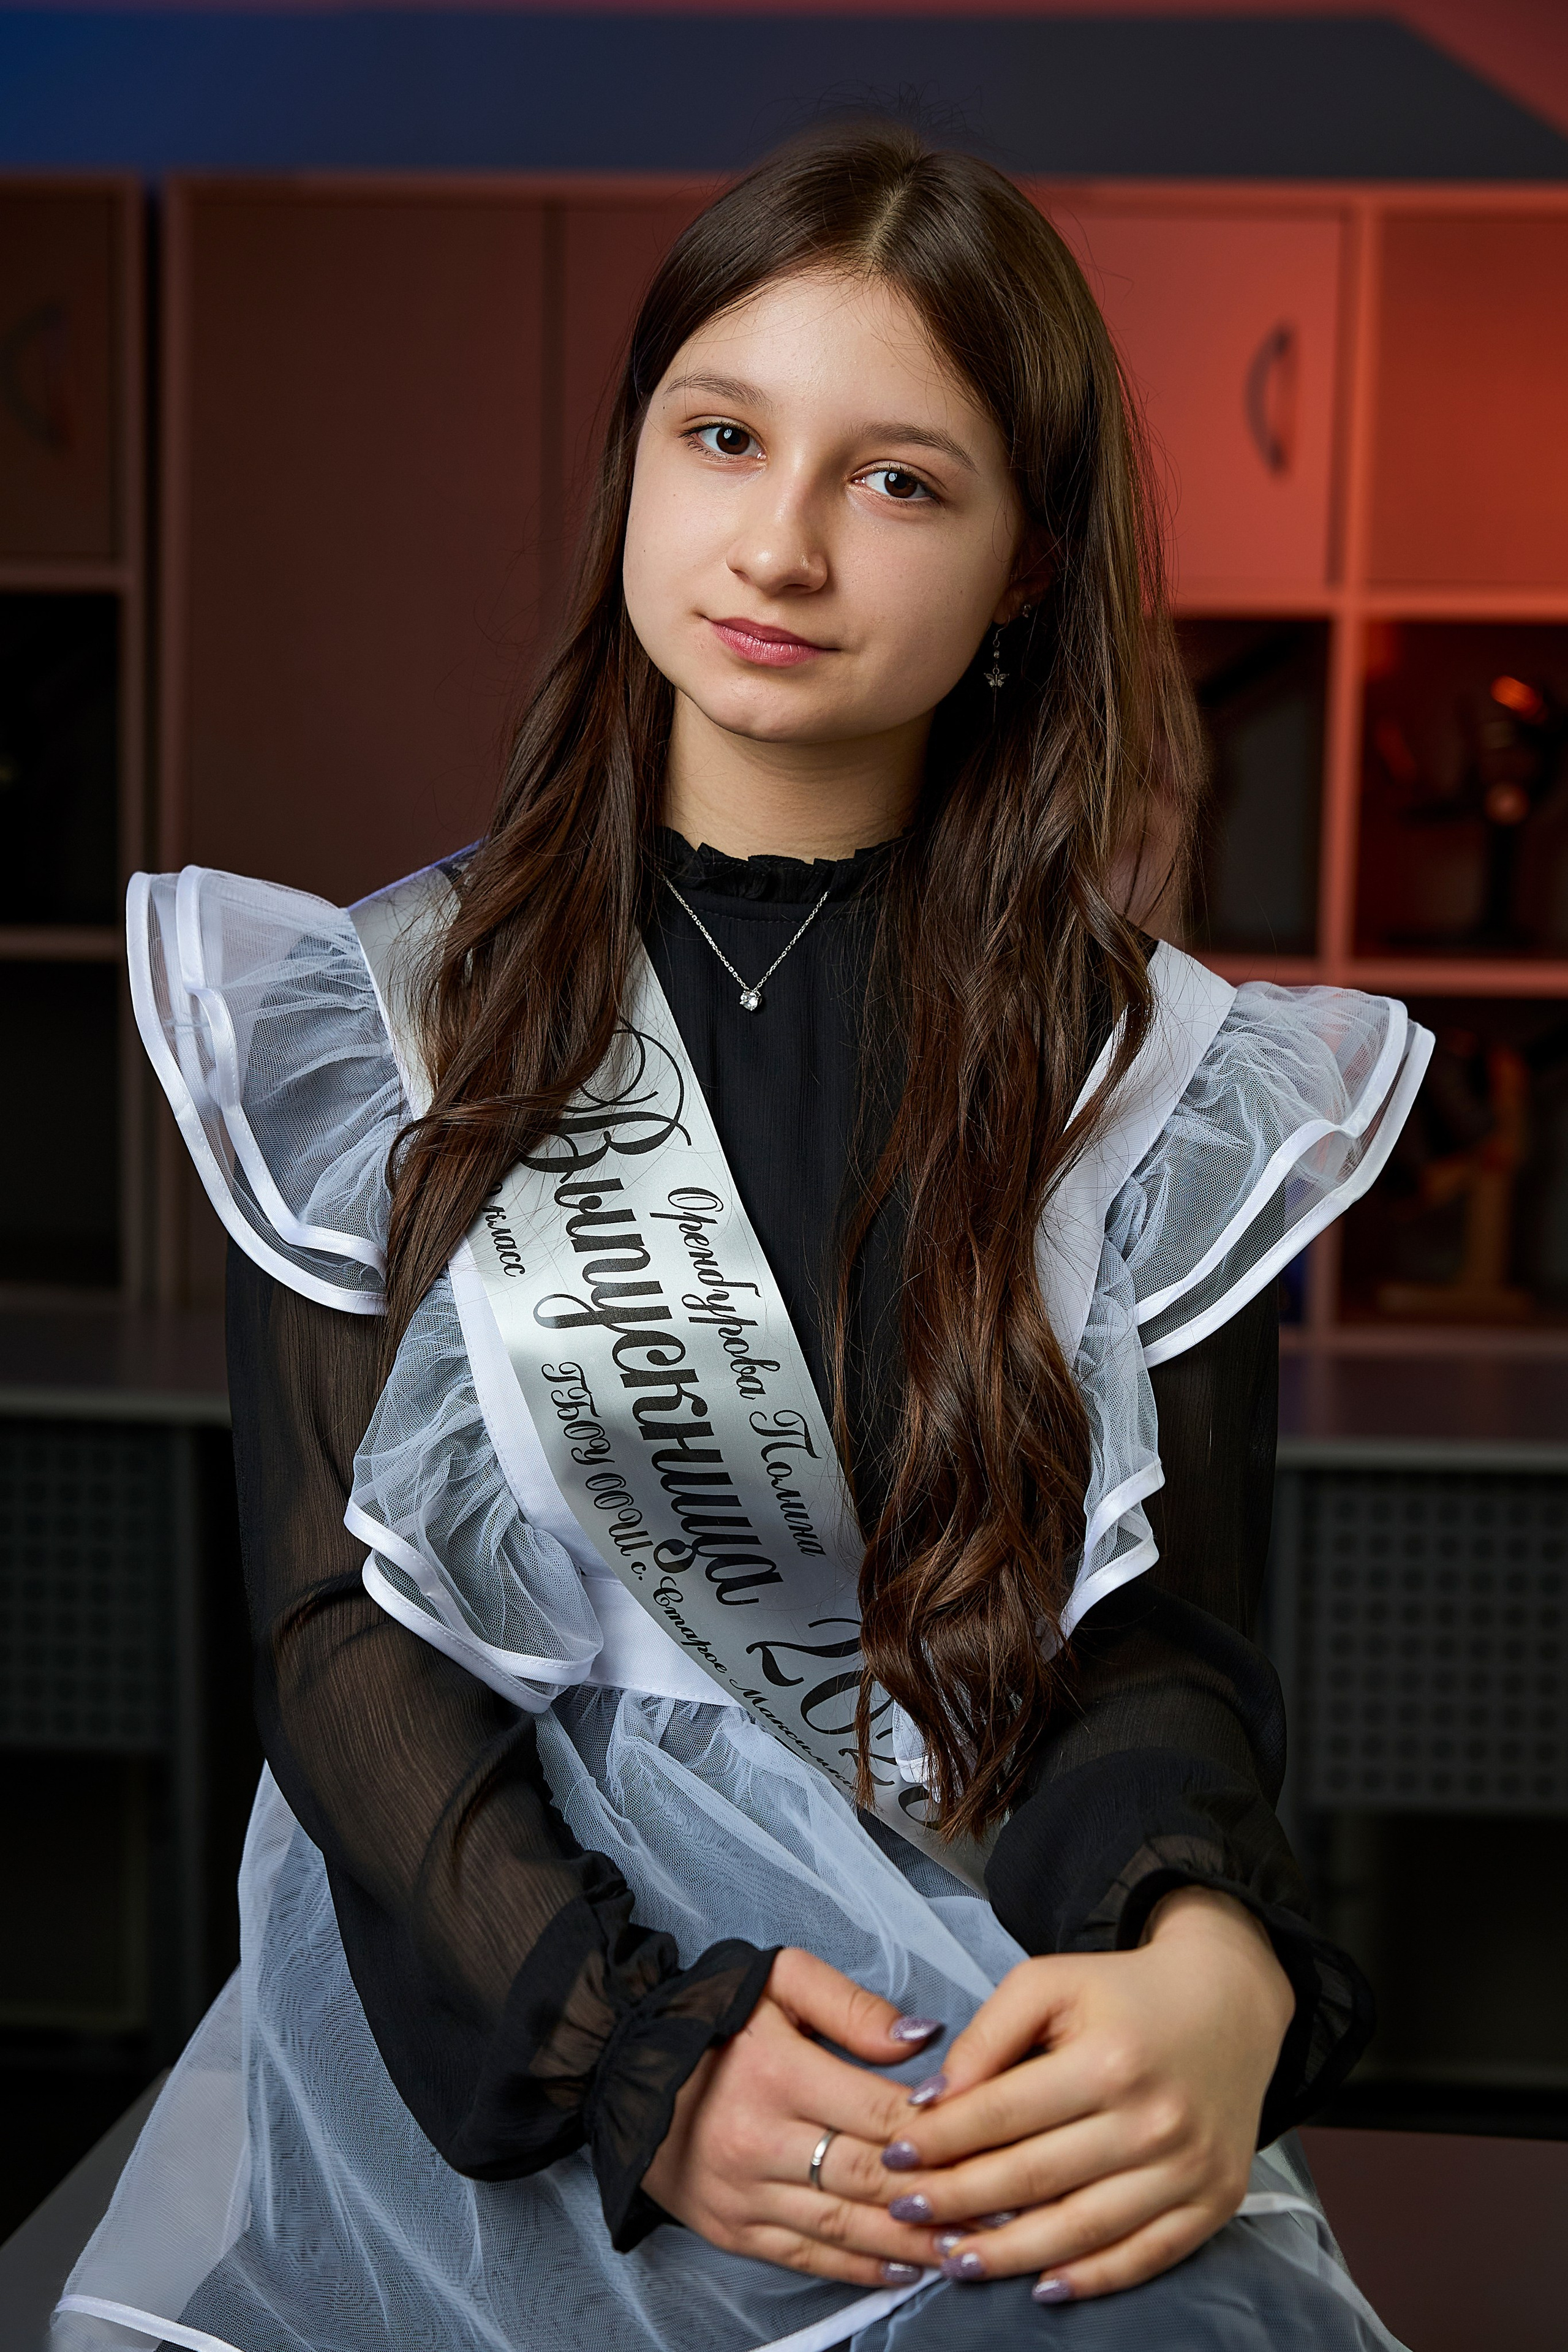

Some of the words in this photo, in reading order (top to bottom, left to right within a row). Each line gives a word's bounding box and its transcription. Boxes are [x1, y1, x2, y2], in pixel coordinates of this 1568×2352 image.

[481, 1204, 526, 1278] класс
[541, 1361, 616, 1466] ГБОУ
[584, 1472, 654, 1557] ООШ
[652, 1575, 728, 1674] Старое
[728, 1677, 859, 1792] Максимки
[519, 1014, 785, 1606] Выпускница
[649, 1186, 781, 1401] Оренбурова
[748, 1409, 827, 1558] Полина
